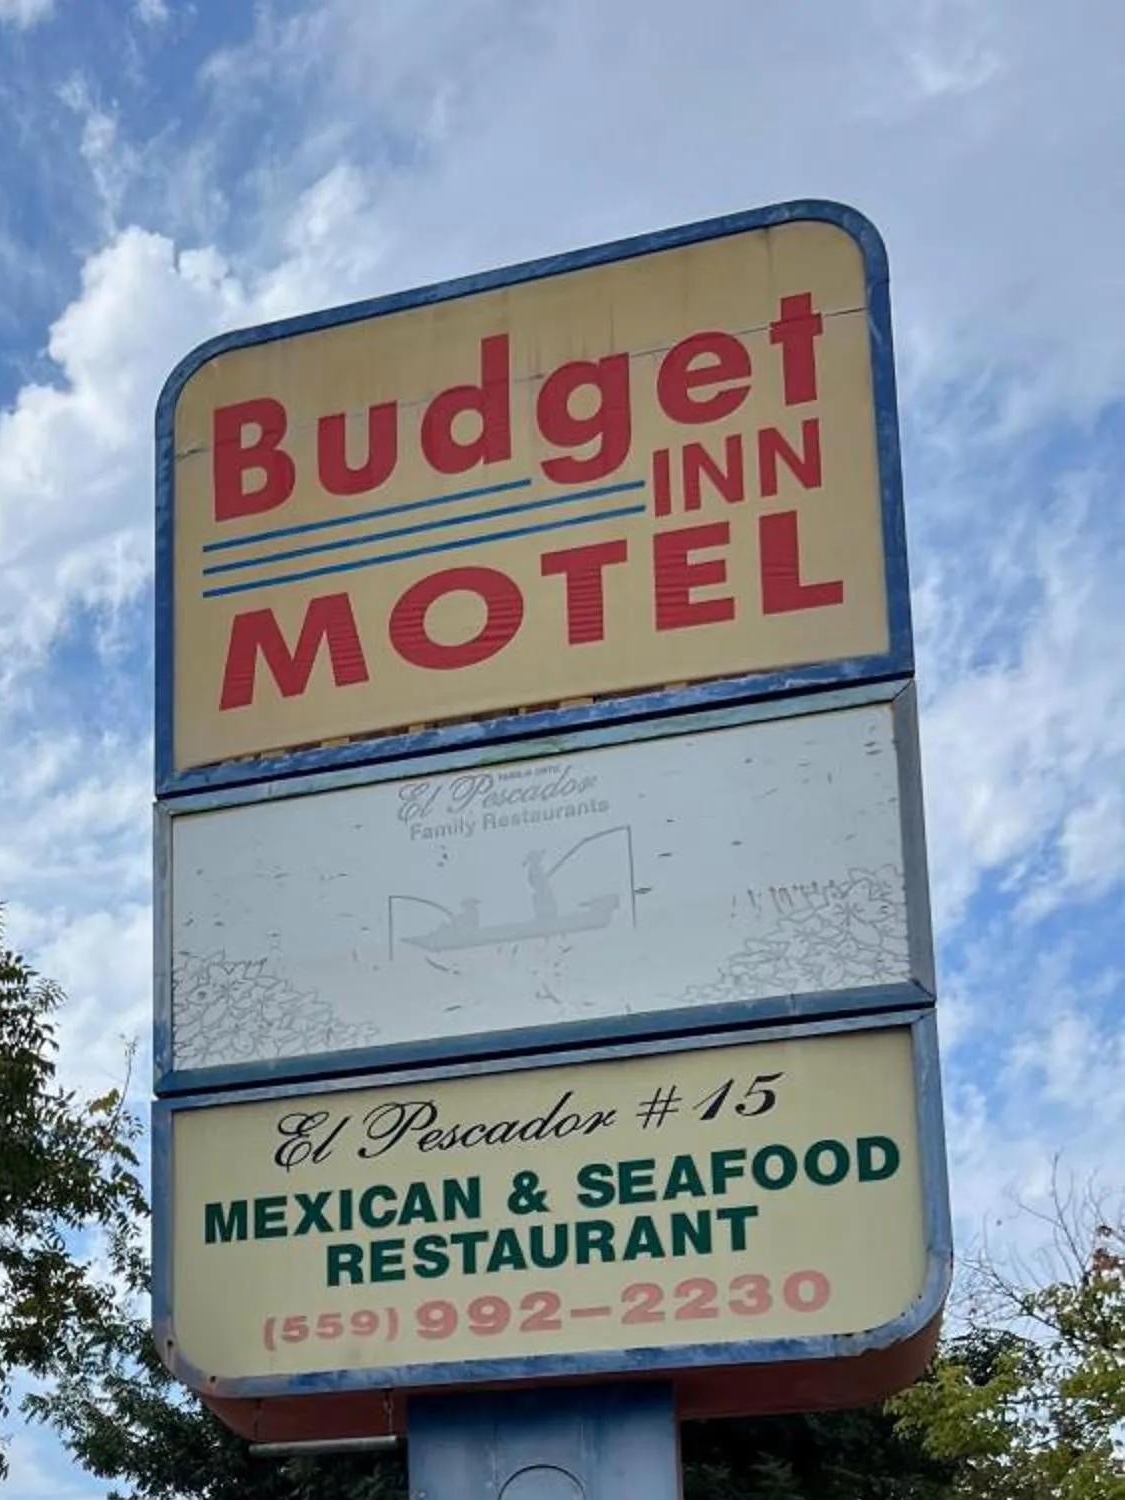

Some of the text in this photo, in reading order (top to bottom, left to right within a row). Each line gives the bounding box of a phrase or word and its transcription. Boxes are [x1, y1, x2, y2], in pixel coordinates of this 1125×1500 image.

[213, 291, 823, 523] Budget
[652, 417, 823, 518] INN
[217, 509, 845, 711] MOTEL
[397, 764, 599, 824] El Pescador
[410, 798, 611, 842] Family Restaurants
[275, 1110, 351, 1173] El
[358, 1090, 617, 1159] Pescador
[204, 1135, 901, 1245] MEXICAN & SEAFOOD
[326, 1205, 759, 1287] RESTAURANT
[262, 1269, 832, 1352] (559) 992-2230
